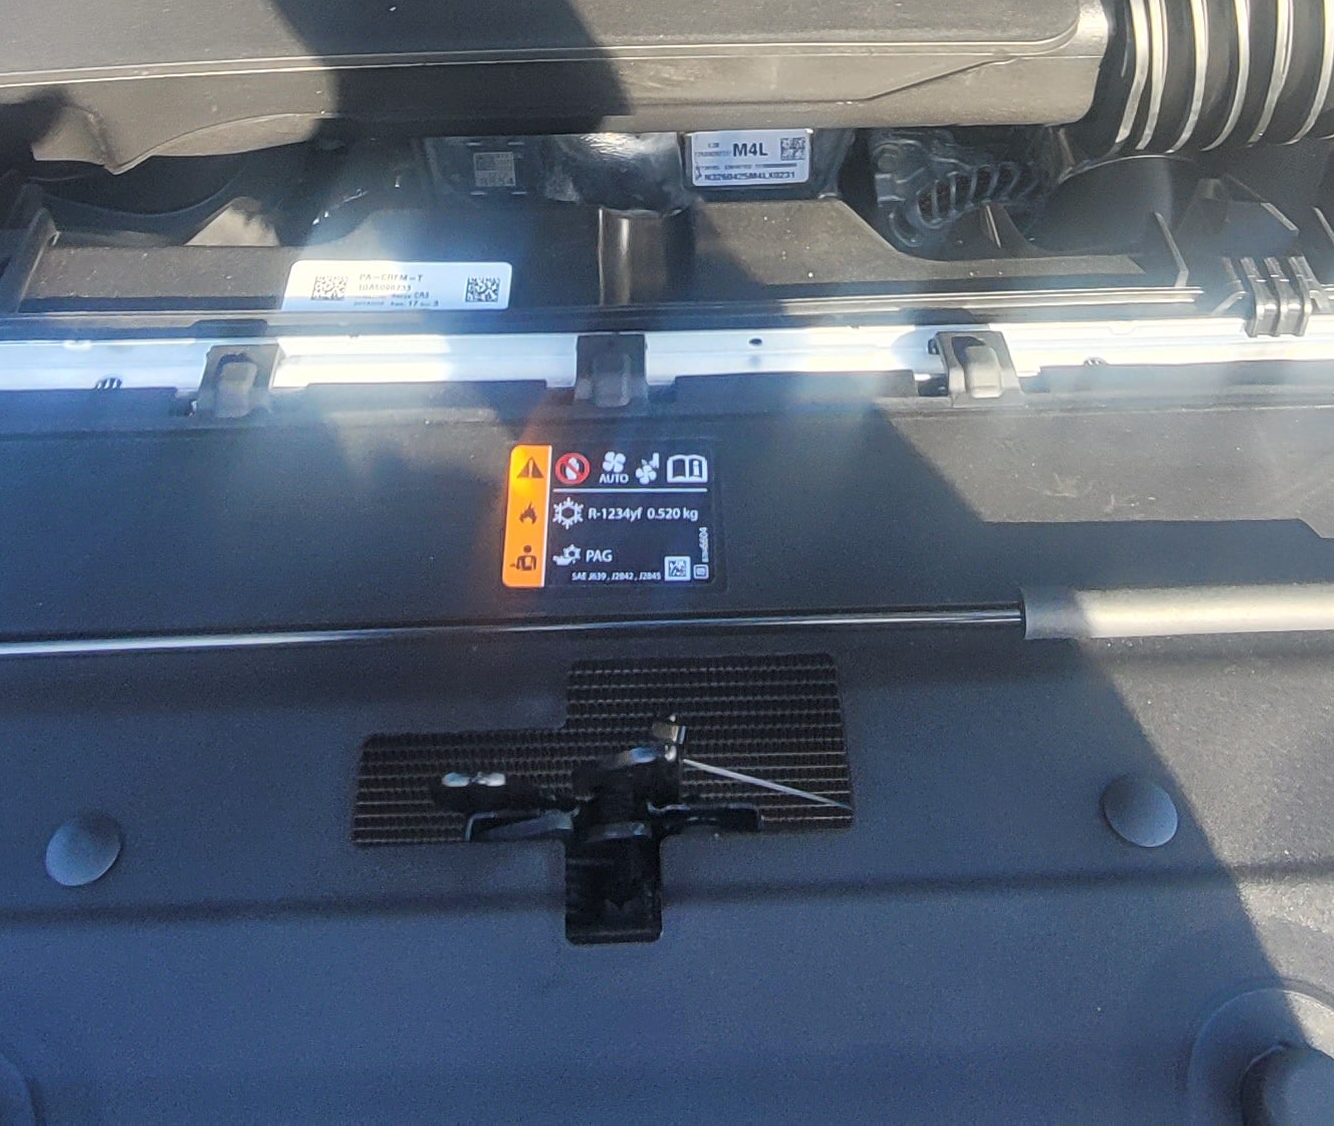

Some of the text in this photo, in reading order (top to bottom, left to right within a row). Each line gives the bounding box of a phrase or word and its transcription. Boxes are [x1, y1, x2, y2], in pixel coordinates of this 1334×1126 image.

[733, 142, 769, 157] M4L
[599, 473, 629, 484] AUTO
[588, 507, 698, 522] R-1234yf 0.520 kg
[585, 550, 613, 562] PAG
[572, 572, 586, 581] SAE
